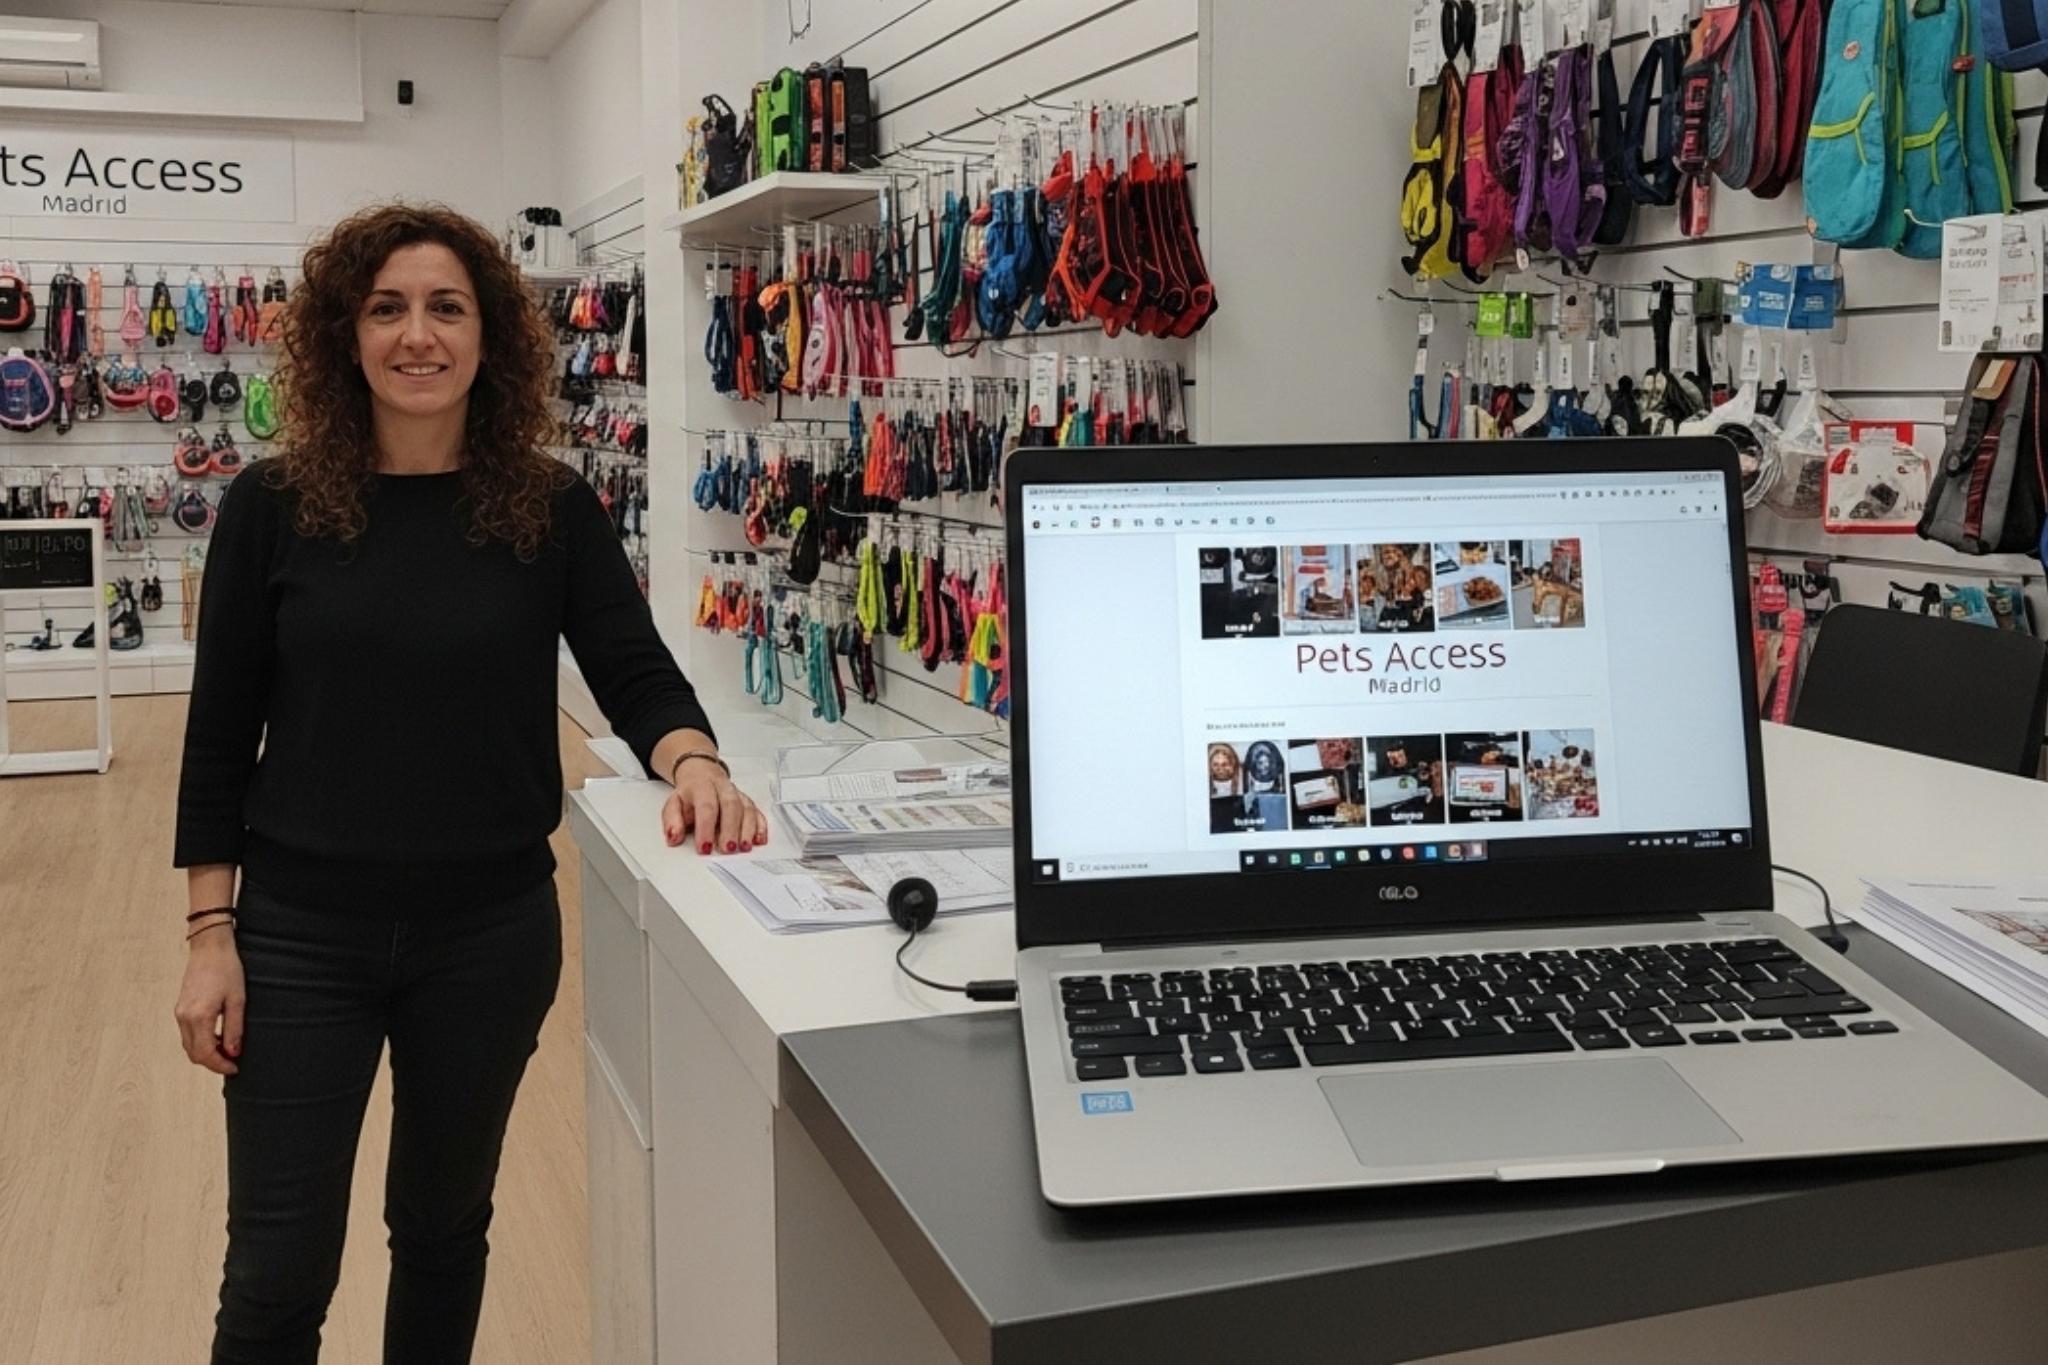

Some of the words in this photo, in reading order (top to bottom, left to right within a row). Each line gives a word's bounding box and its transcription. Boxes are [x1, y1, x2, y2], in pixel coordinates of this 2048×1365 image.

[64, 147, 243, 193] Access
[43, 194, 127, 214] Madrid
[1296, 643, 1373, 673] Pets
[1385, 641, 1507, 672] Access
